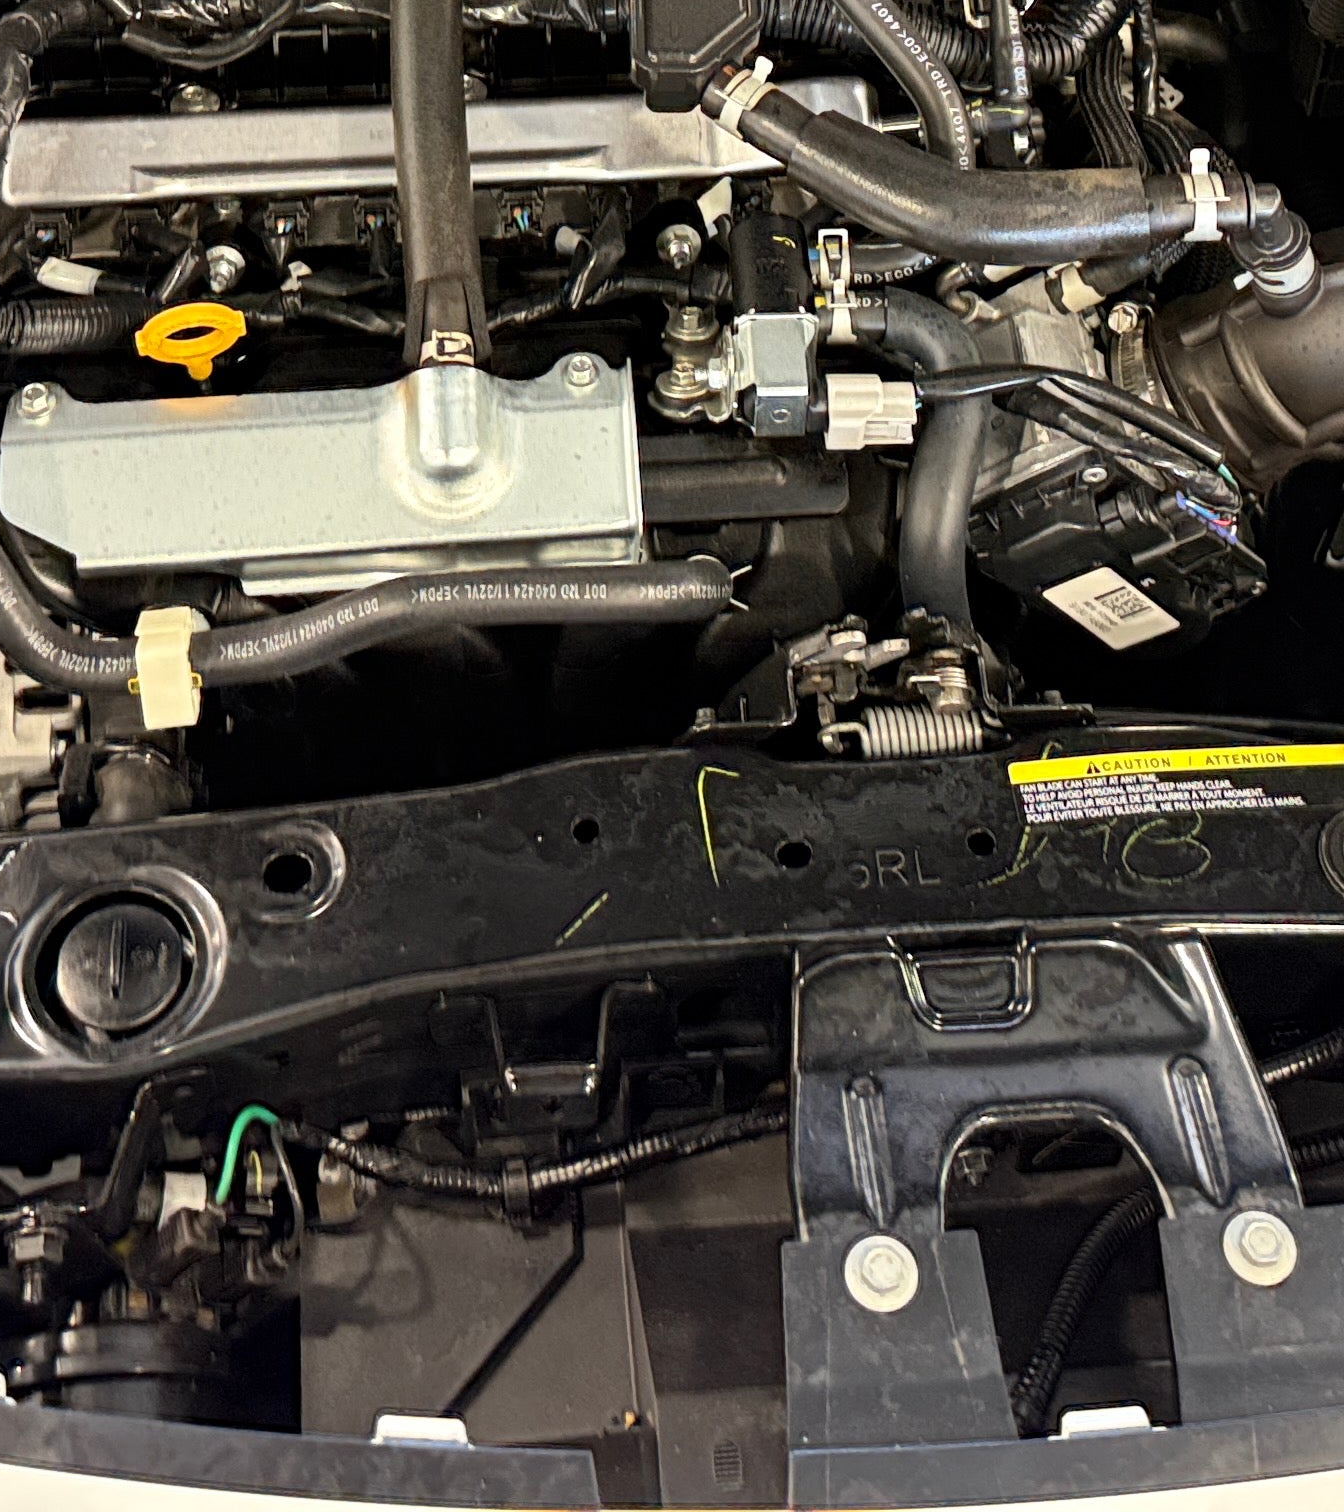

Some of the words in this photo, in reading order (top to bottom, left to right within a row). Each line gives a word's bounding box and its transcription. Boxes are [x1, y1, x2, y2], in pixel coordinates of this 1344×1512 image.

[410, 586, 459, 605] >EPDM<
[584, 584, 607, 600] DOT
[358, 596, 379, 614] DOT
[219, 638, 262, 662] >EPDM<
[1102, 756, 1171, 772] CAUTION
[1205, 752, 1287, 766] ATTENTION
[1019, 783, 1037, 794] FAN
[1037, 780, 1063, 792] BLADE
[1064, 779, 1083, 790] CAN
[1083, 777, 1108, 788] START
[1109, 776, 1119, 785] AT
[1120, 775, 1137, 785] ANY
[1022, 793, 1035, 803] TO
[1036, 791, 1056, 802] HELP
[1057, 789, 1083, 800] AVOID
[1083, 786, 1126, 799] PERSONAL
[1156, 781, 1175, 792] KEEP
[1176, 780, 1205, 791] HANDS
[1024, 804, 1035, 814] LE
[1035, 797, 1095, 813] VENTILATEUR
[1095, 794, 1129, 807] RISQUE
[1129, 793, 1141, 804] DE
[1200, 789, 1223, 800] TOUT
[1026, 813, 1053, 824] POUR
[1083, 807, 1114, 819] TOUTE
[1161, 801, 1174, 812] NE
[1175, 800, 1191, 811] PAS
[1192, 800, 1205, 811] EN
[1206, 797, 1257, 810] APPROCHER
[1257, 797, 1273, 807] LES
